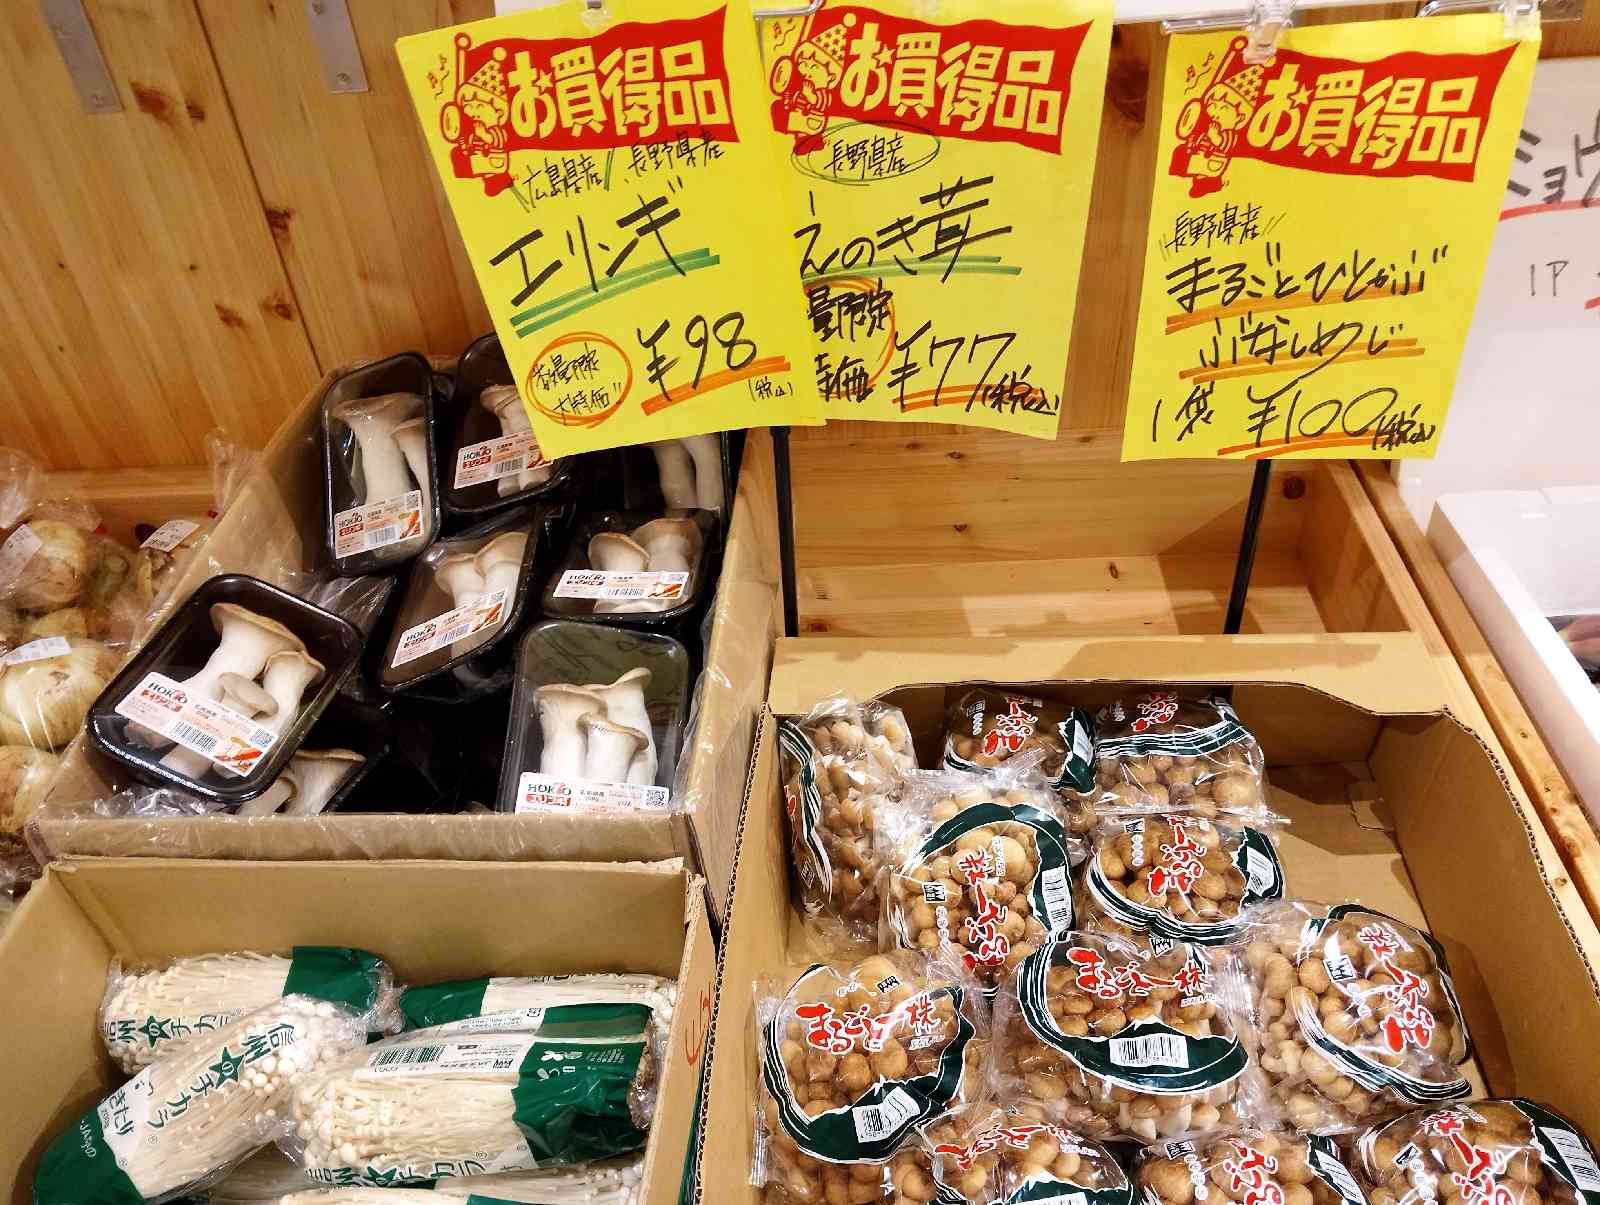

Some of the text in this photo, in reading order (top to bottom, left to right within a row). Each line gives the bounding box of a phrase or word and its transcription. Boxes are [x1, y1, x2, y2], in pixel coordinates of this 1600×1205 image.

[509, 40, 731, 138] お買得品
[840, 23, 1062, 135] お買得品
[1247, 64, 1481, 169] お買得品
[522, 133, 725, 201] 広島県産 長野県産
[824, 133, 911, 180] 長野県産
[489, 178, 686, 307] エリンギ
[794, 176, 1013, 284] えのき茸
[1165, 202, 1263, 252] 長野県産
[1165, 242, 1448, 313] まるごとひとかぶ
[1200, 311, 1403, 375] ぶなしめじ
